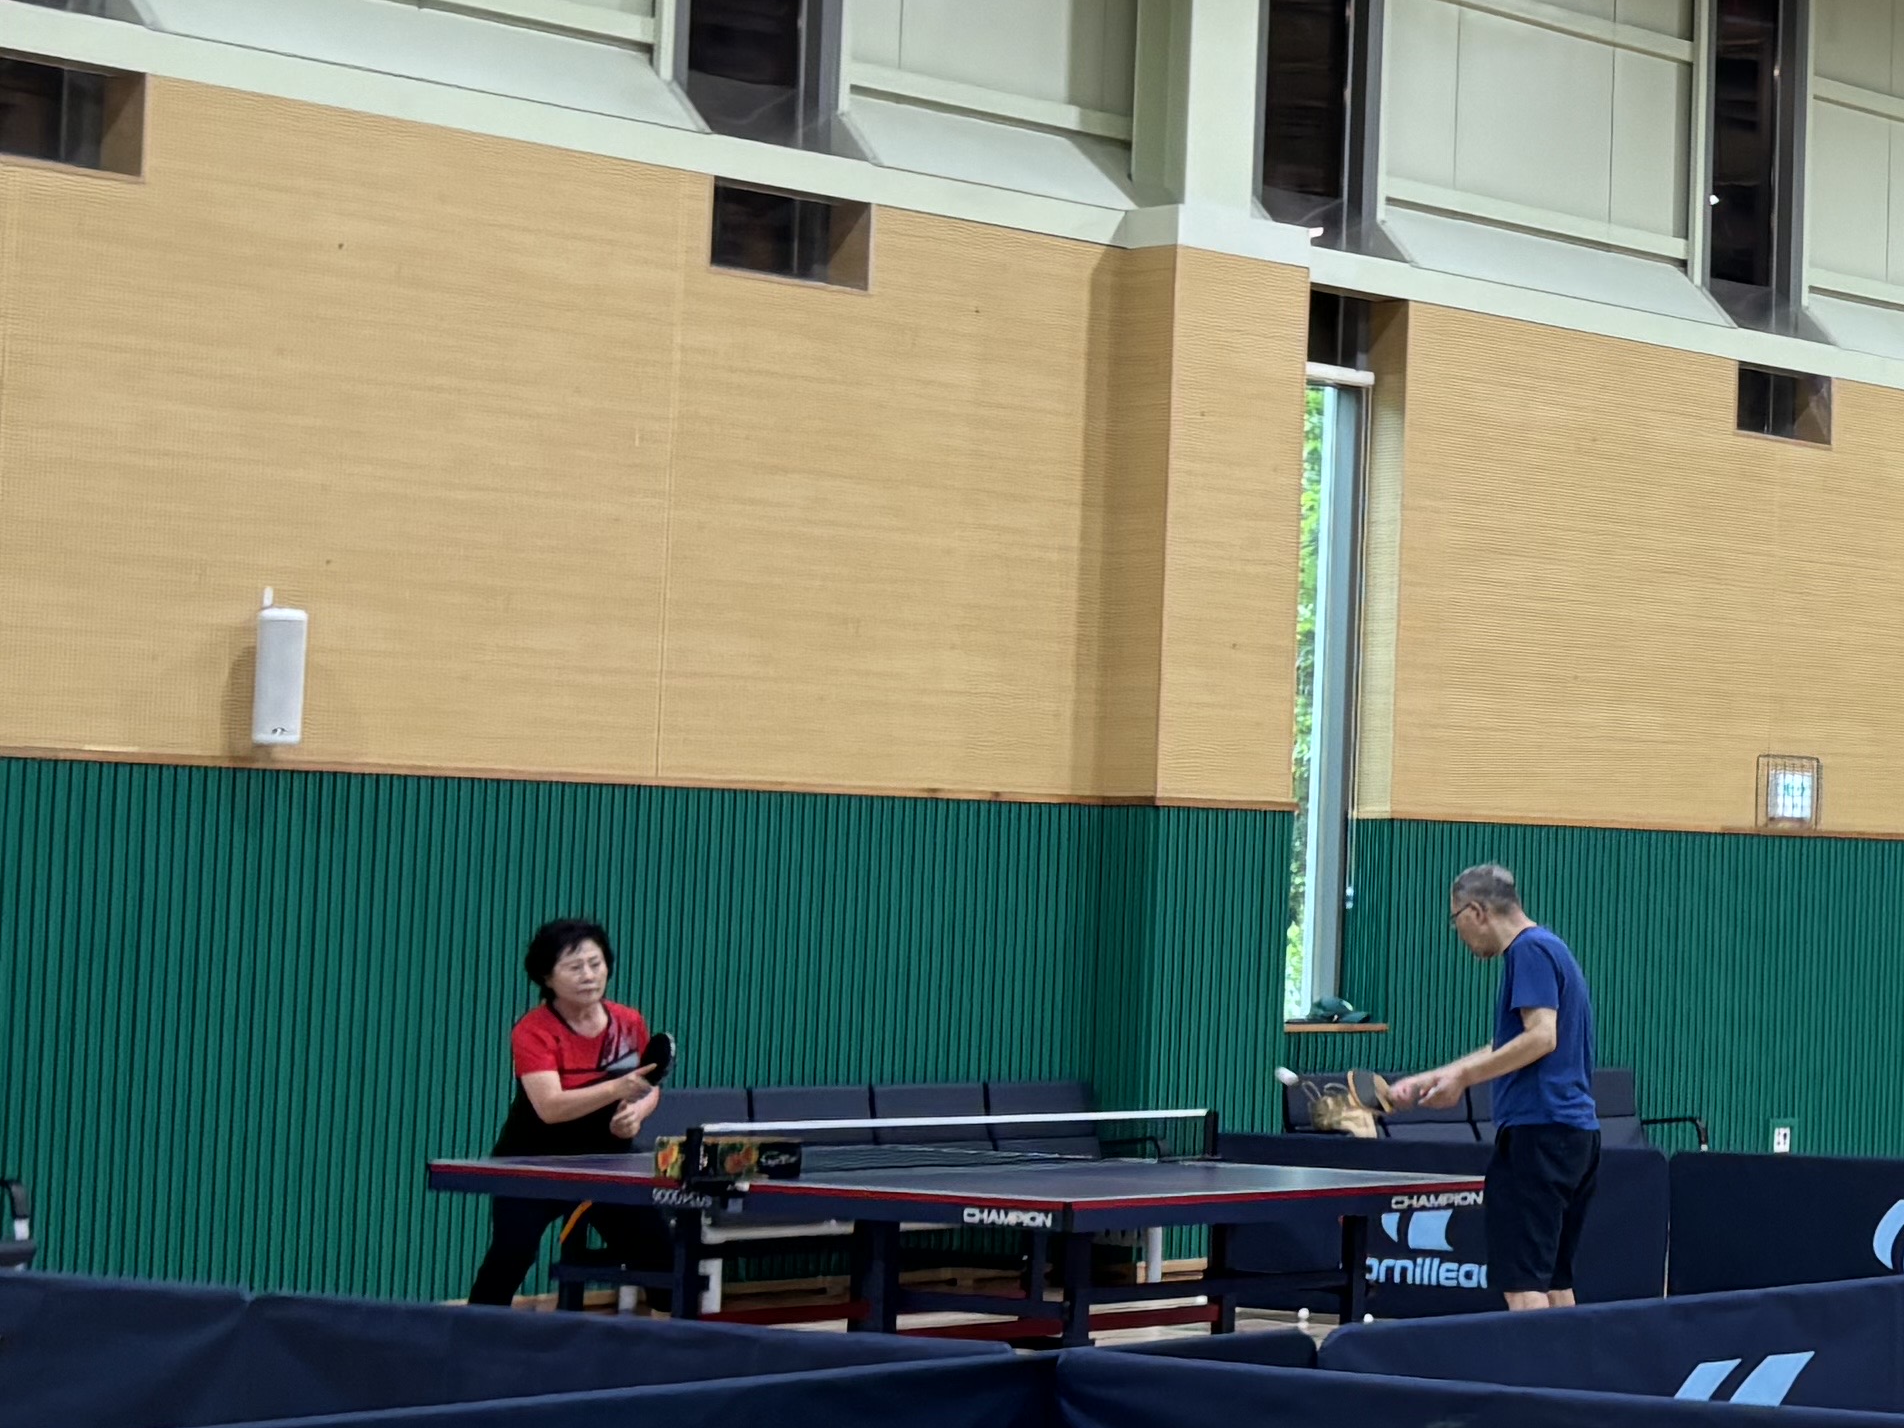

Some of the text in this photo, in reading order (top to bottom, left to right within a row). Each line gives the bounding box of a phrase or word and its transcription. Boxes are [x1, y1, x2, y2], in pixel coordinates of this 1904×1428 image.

[1391, 1190, 1484, 1210] CHAMPION
[963, 1207, 1053, 1228] CHAMPION
[1365, 1257, 1488, 1289] ornillea
